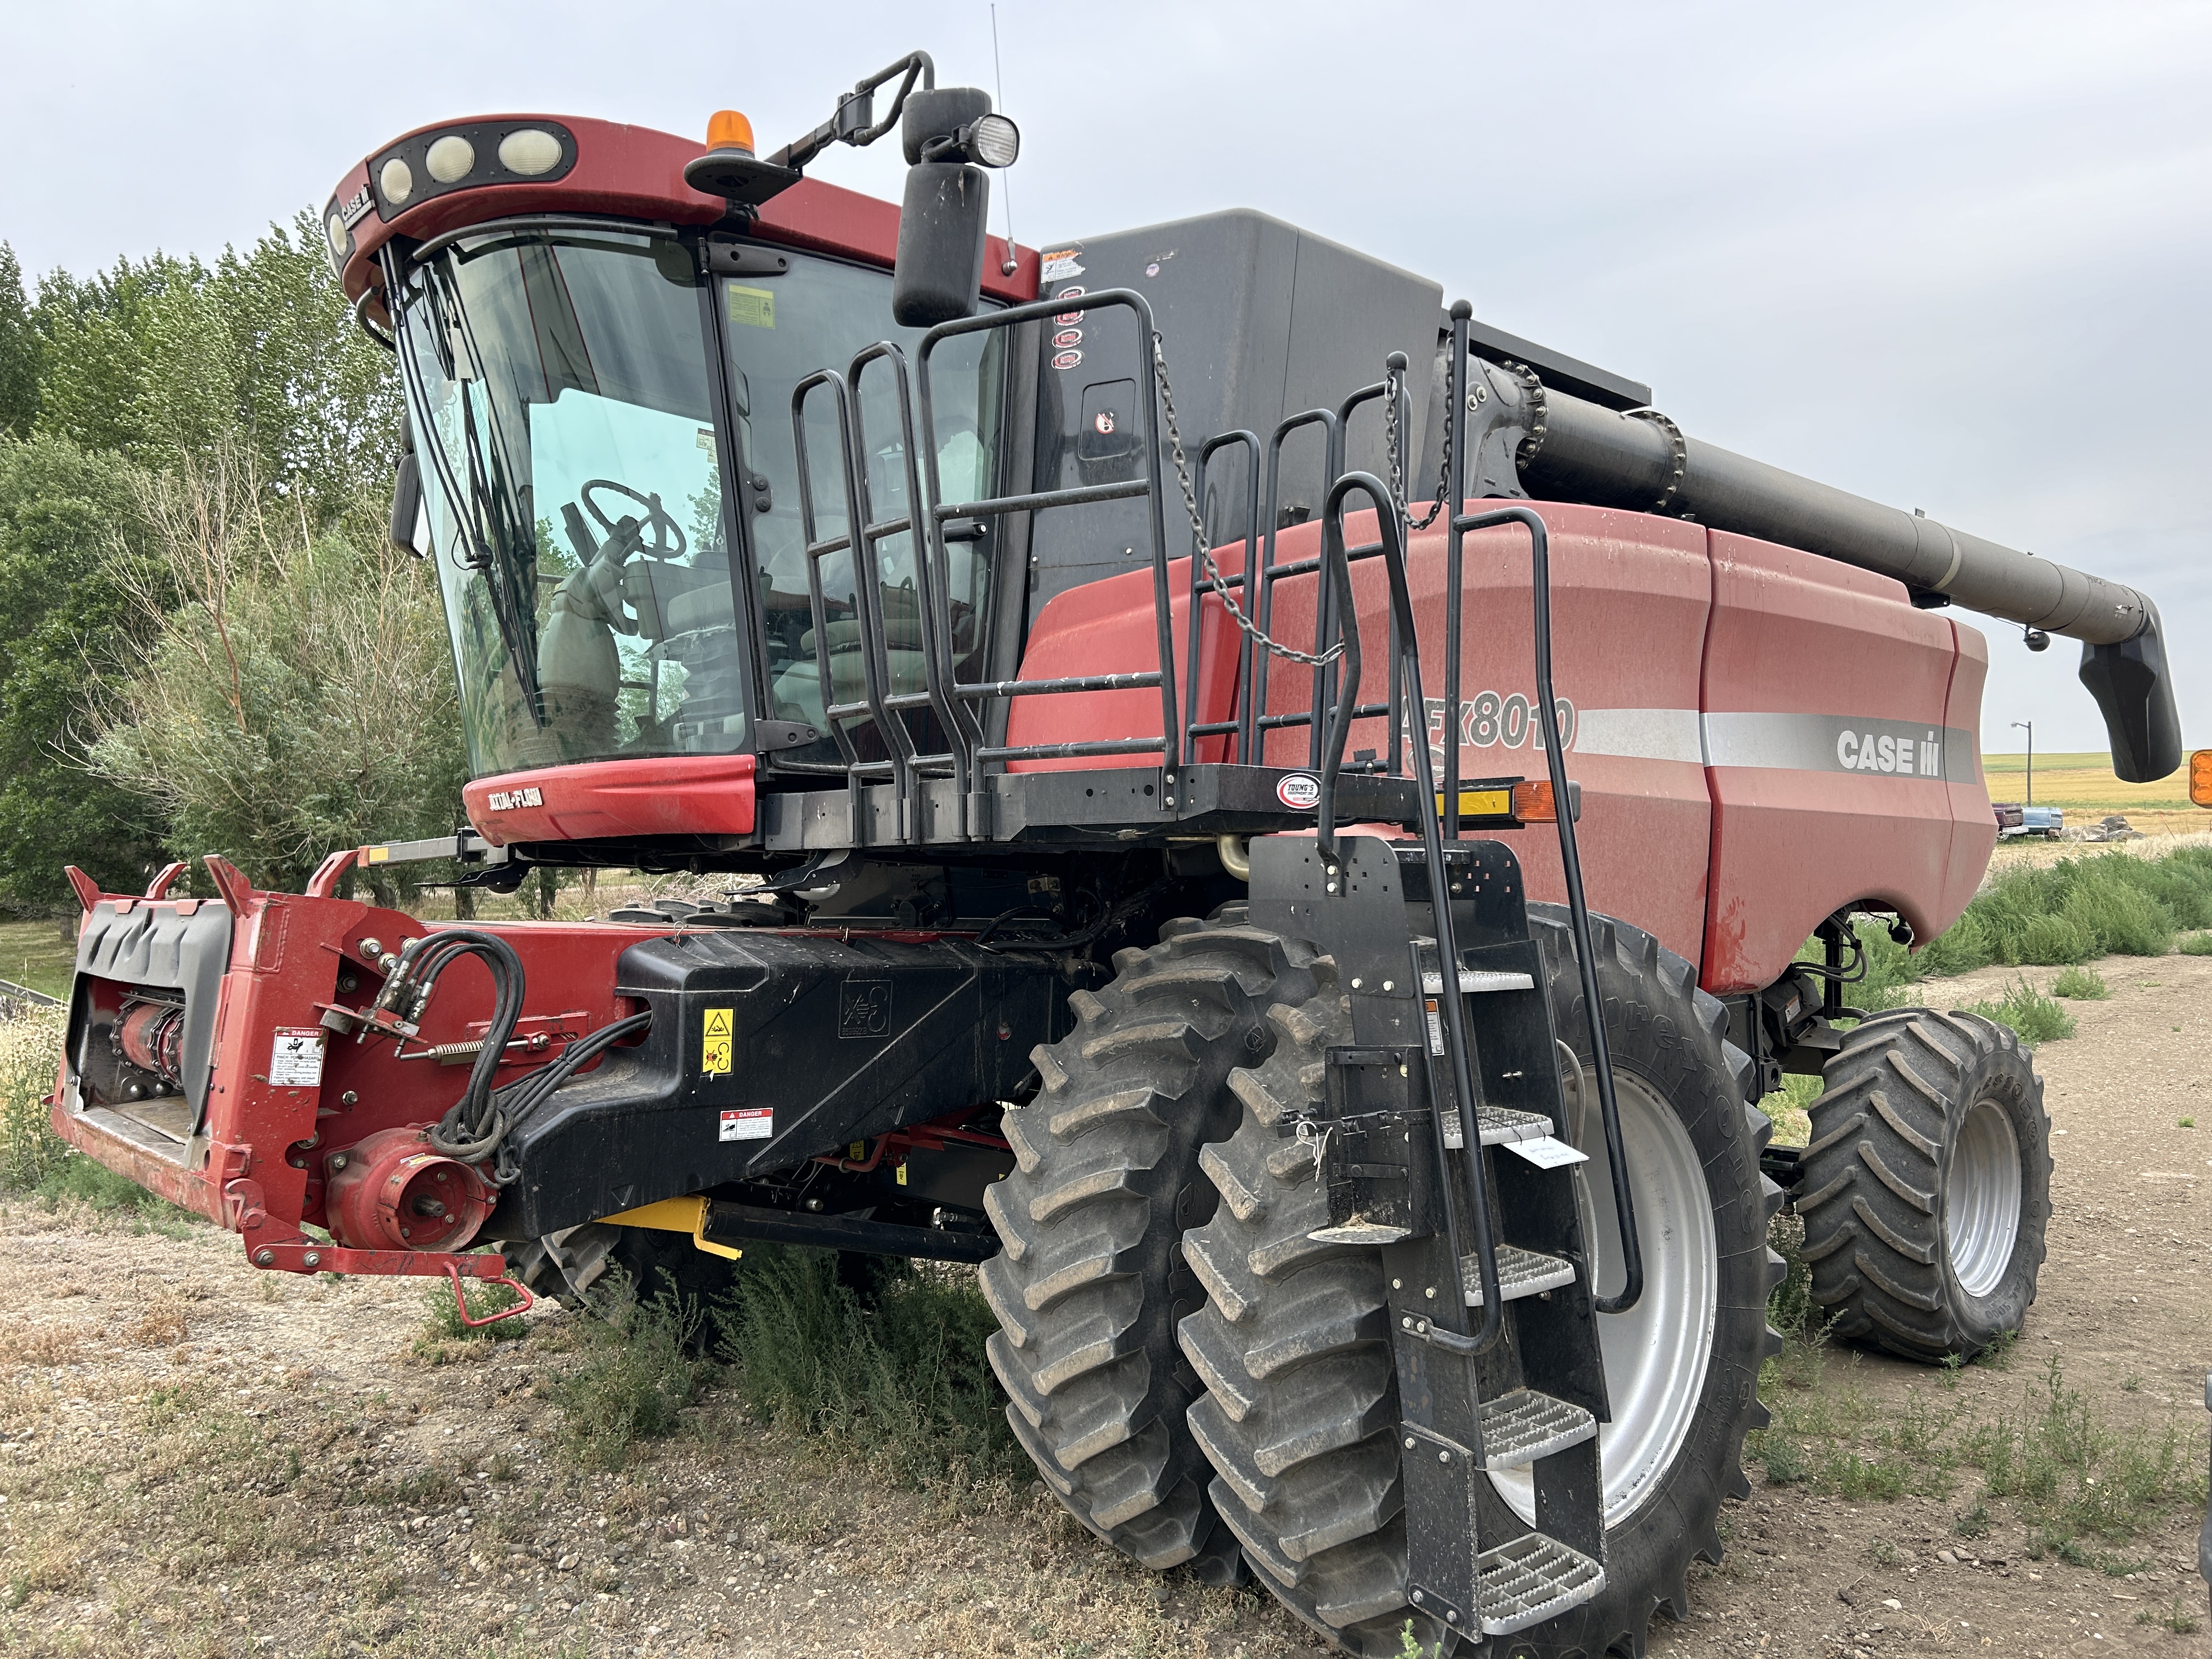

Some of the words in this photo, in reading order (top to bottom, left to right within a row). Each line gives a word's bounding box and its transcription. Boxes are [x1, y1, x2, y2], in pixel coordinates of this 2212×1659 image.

[342, 193, 362, 221] CASE
[1837, 730, 1914, 772] CASE
[488, 787, 543, 811] AXIAL-FLOW
